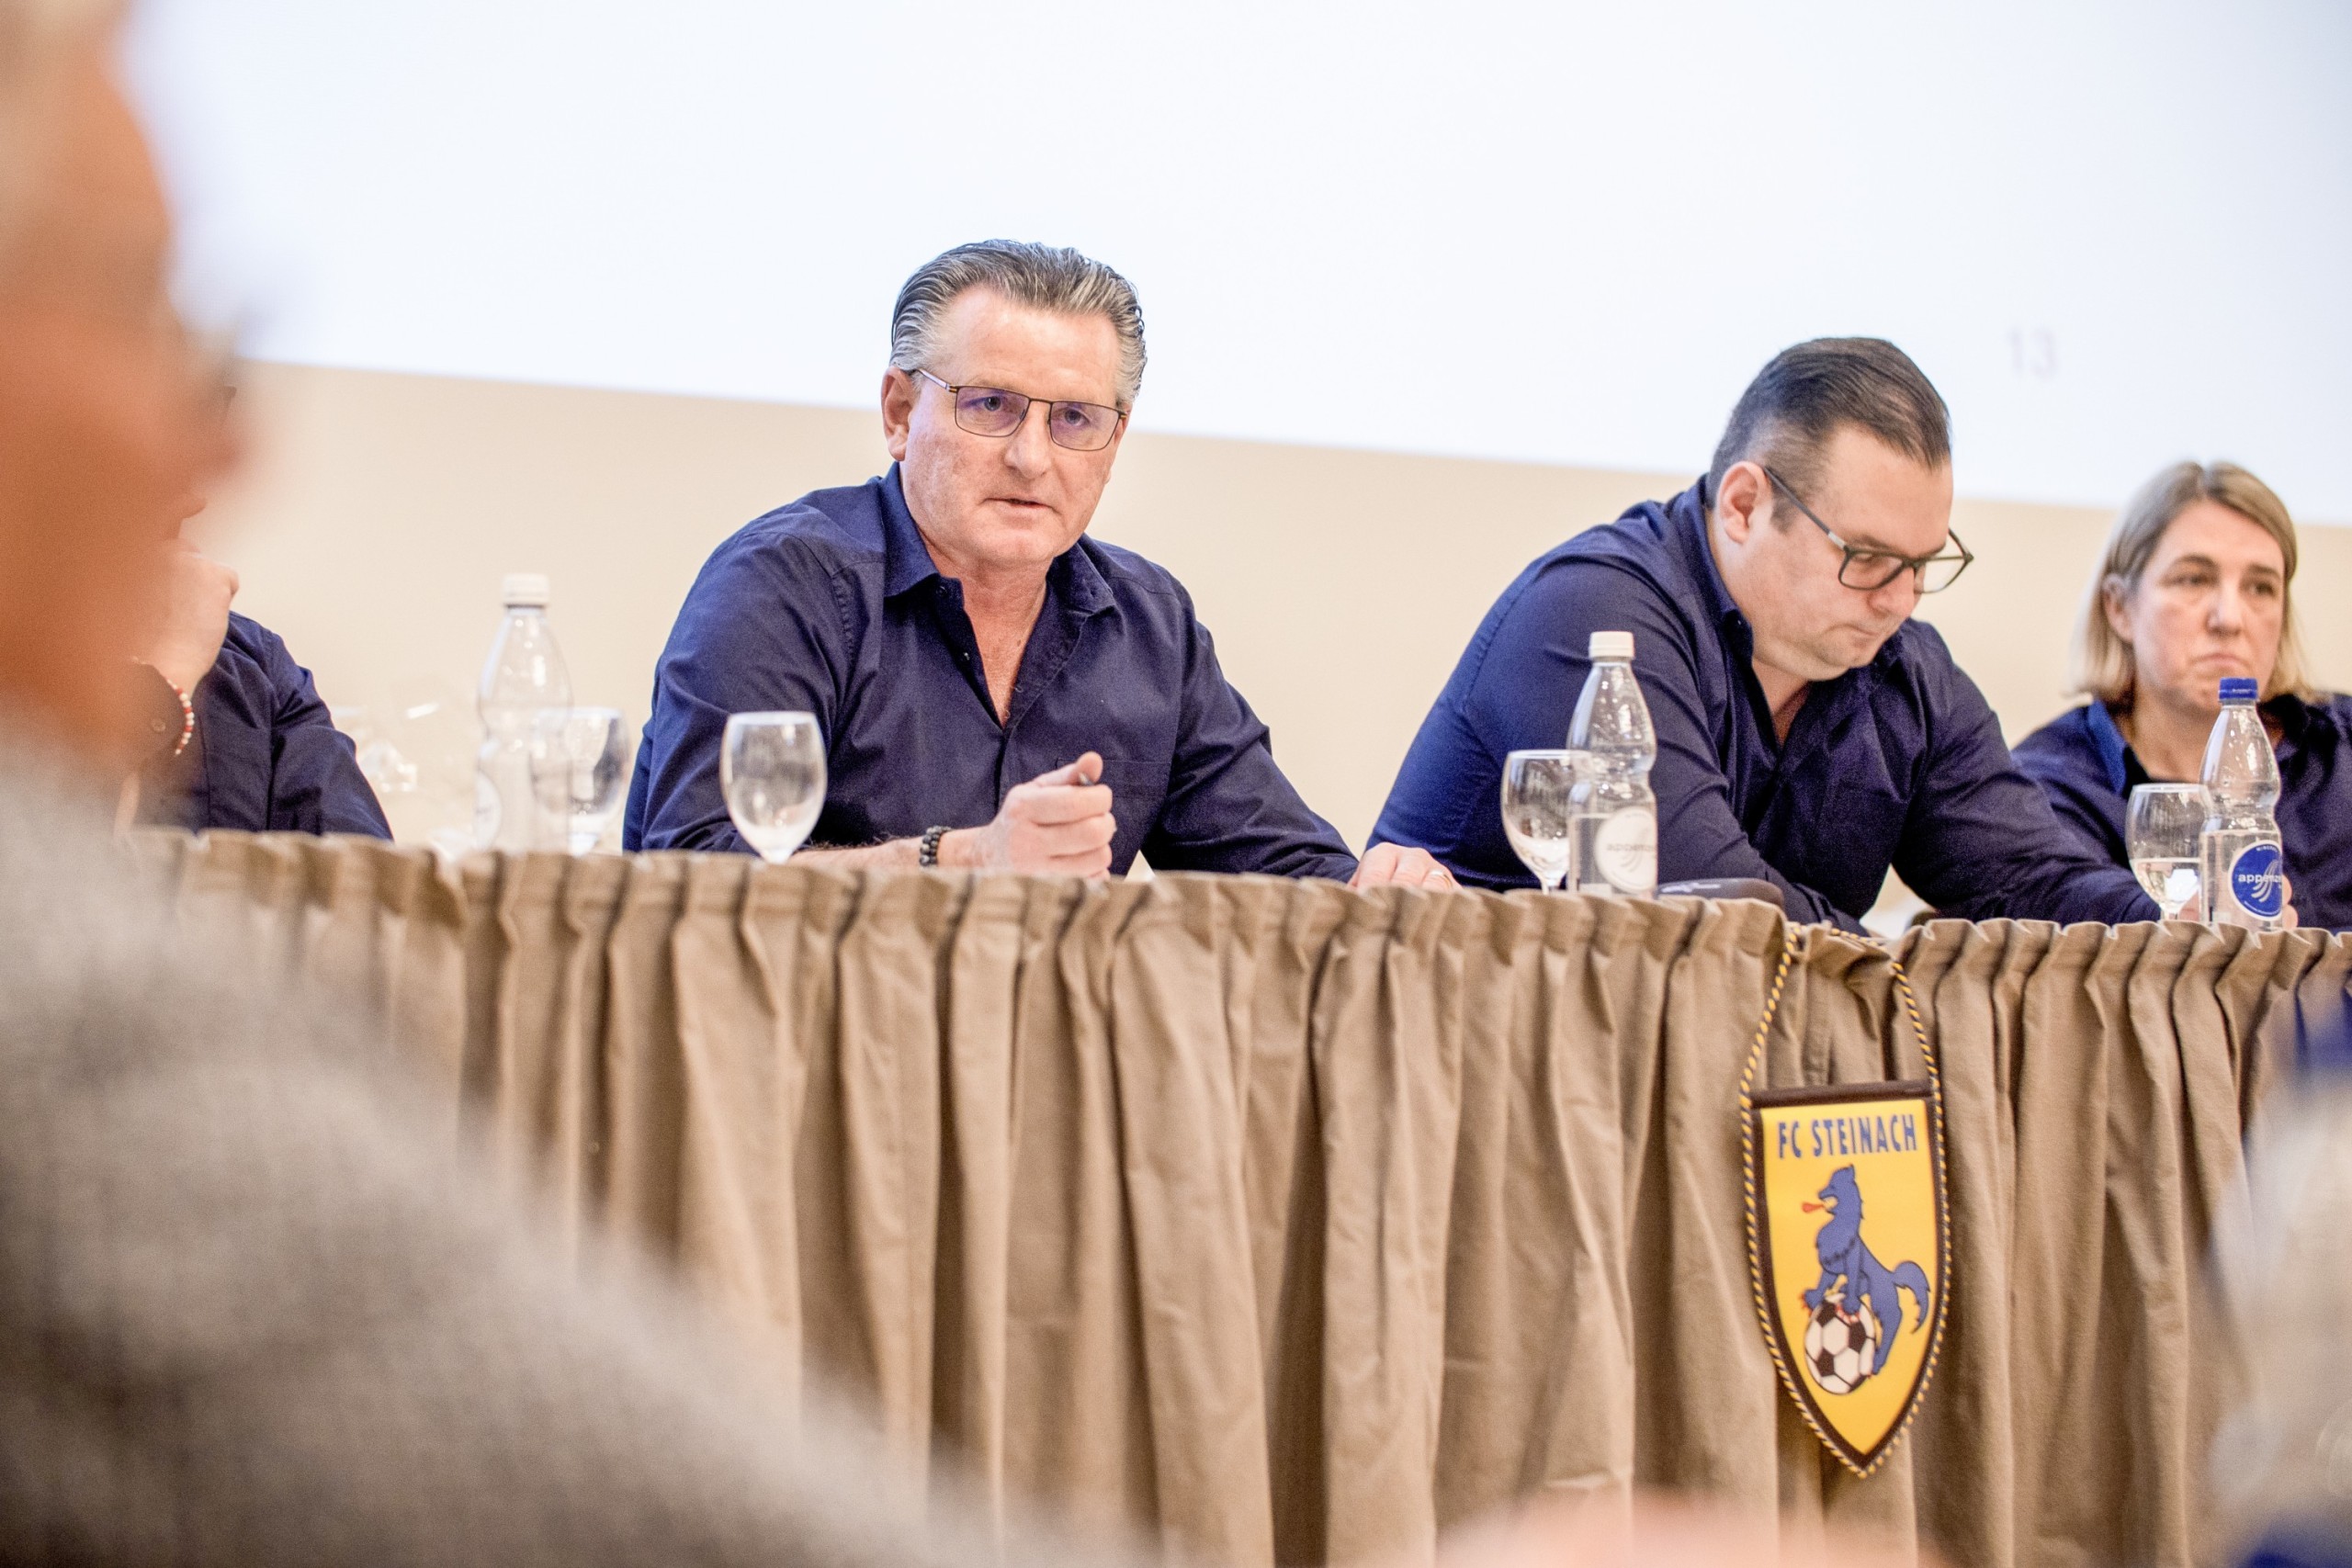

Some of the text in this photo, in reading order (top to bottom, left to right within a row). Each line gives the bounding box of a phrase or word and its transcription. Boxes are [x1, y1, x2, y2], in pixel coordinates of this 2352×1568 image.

[2007, 326, 2059, 380] 13
[1778, 1113, 1917, 1158] FC STEINACH
